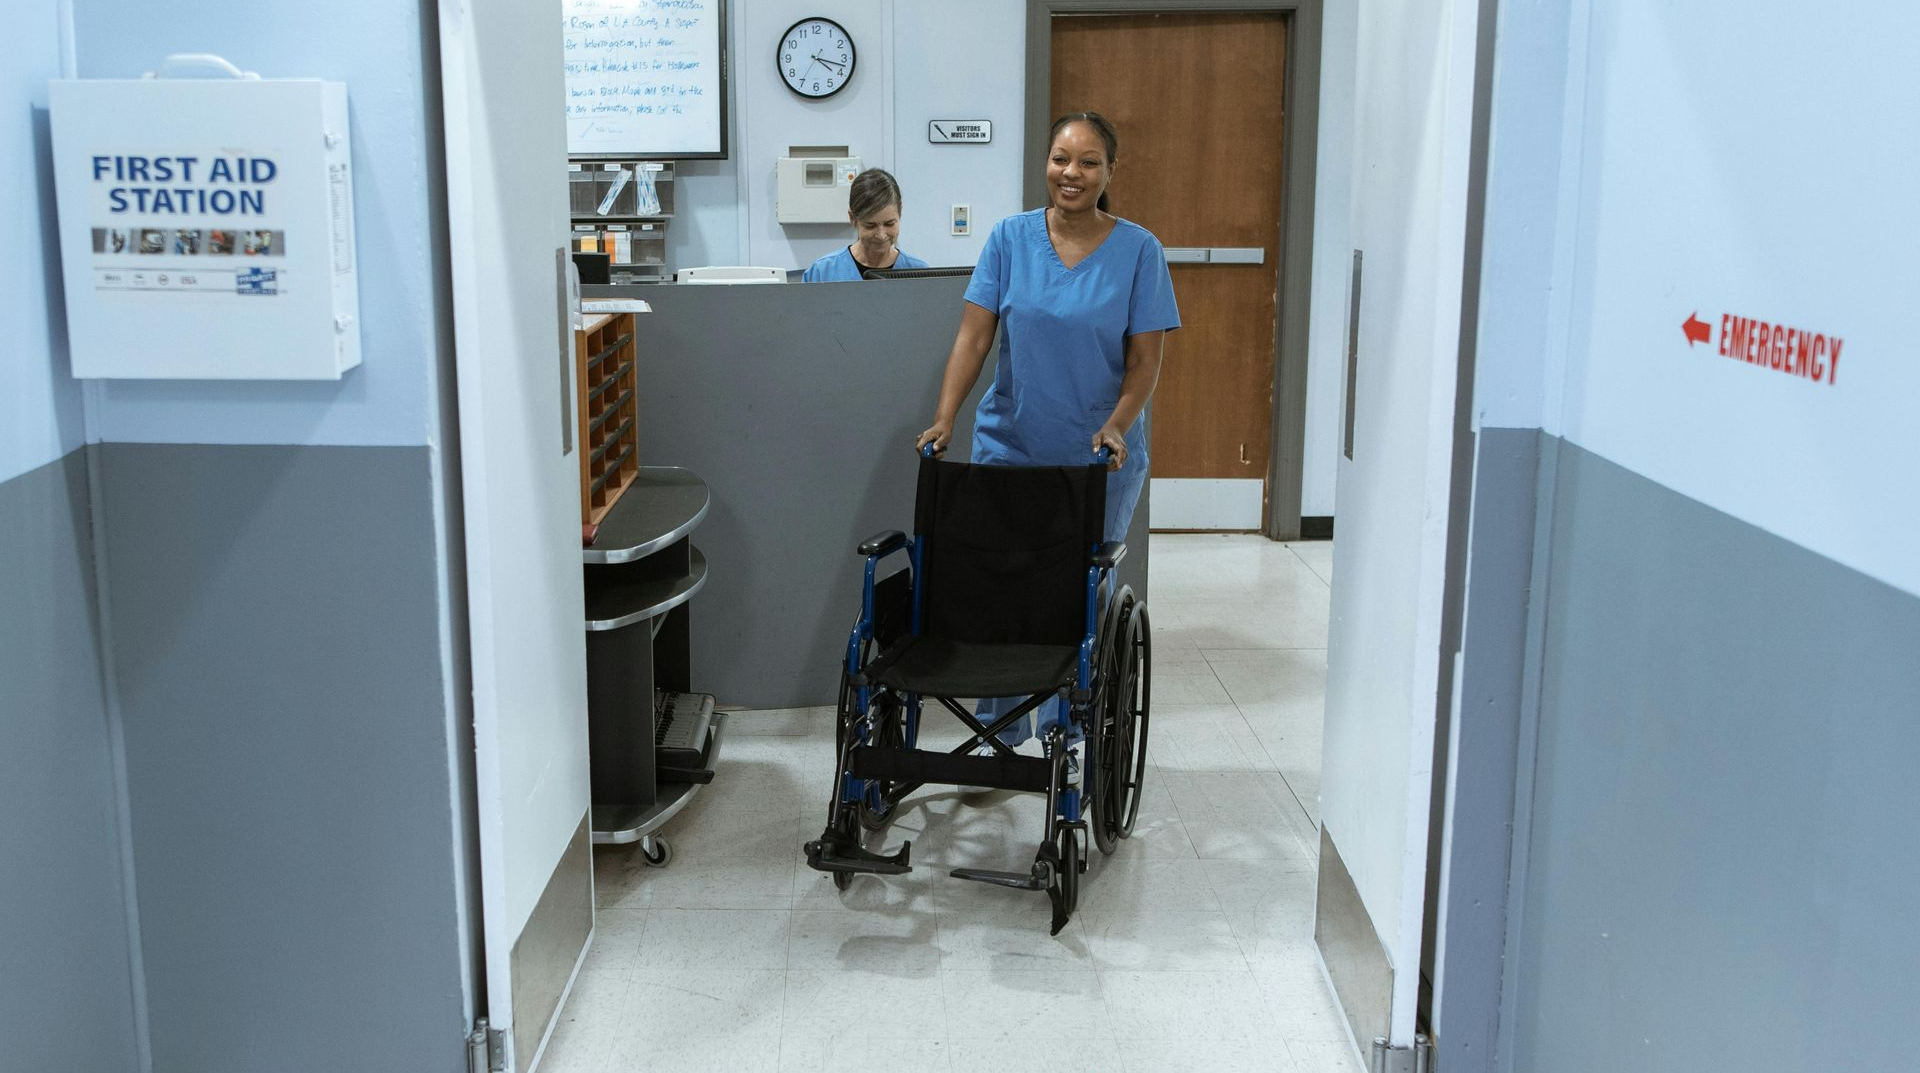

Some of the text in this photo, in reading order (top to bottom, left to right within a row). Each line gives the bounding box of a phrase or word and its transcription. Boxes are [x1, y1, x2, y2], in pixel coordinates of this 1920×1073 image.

[799, 29, 808, 38] 11
[811, 25, 822, 35] 12
[639, 38, 651, 48] but
[788, 40, 797, 49] 10
[837, 39, 844, 49] 2
[785, 54, 792, 64] 9
[841, 54, 848, 64] 3
[789, 68, 796, 78] 8
[837, 68, 844, 78] 4
[799, 78, 806, 88] 7
[813, 82, 820, 92] 6
[827, 78, 834, 88] 5
[92, 155, 278, 184] FIRST AID
[109, 187, 266, 215] STATION
[1719, 313, 1843, 385] EMERGENCY
